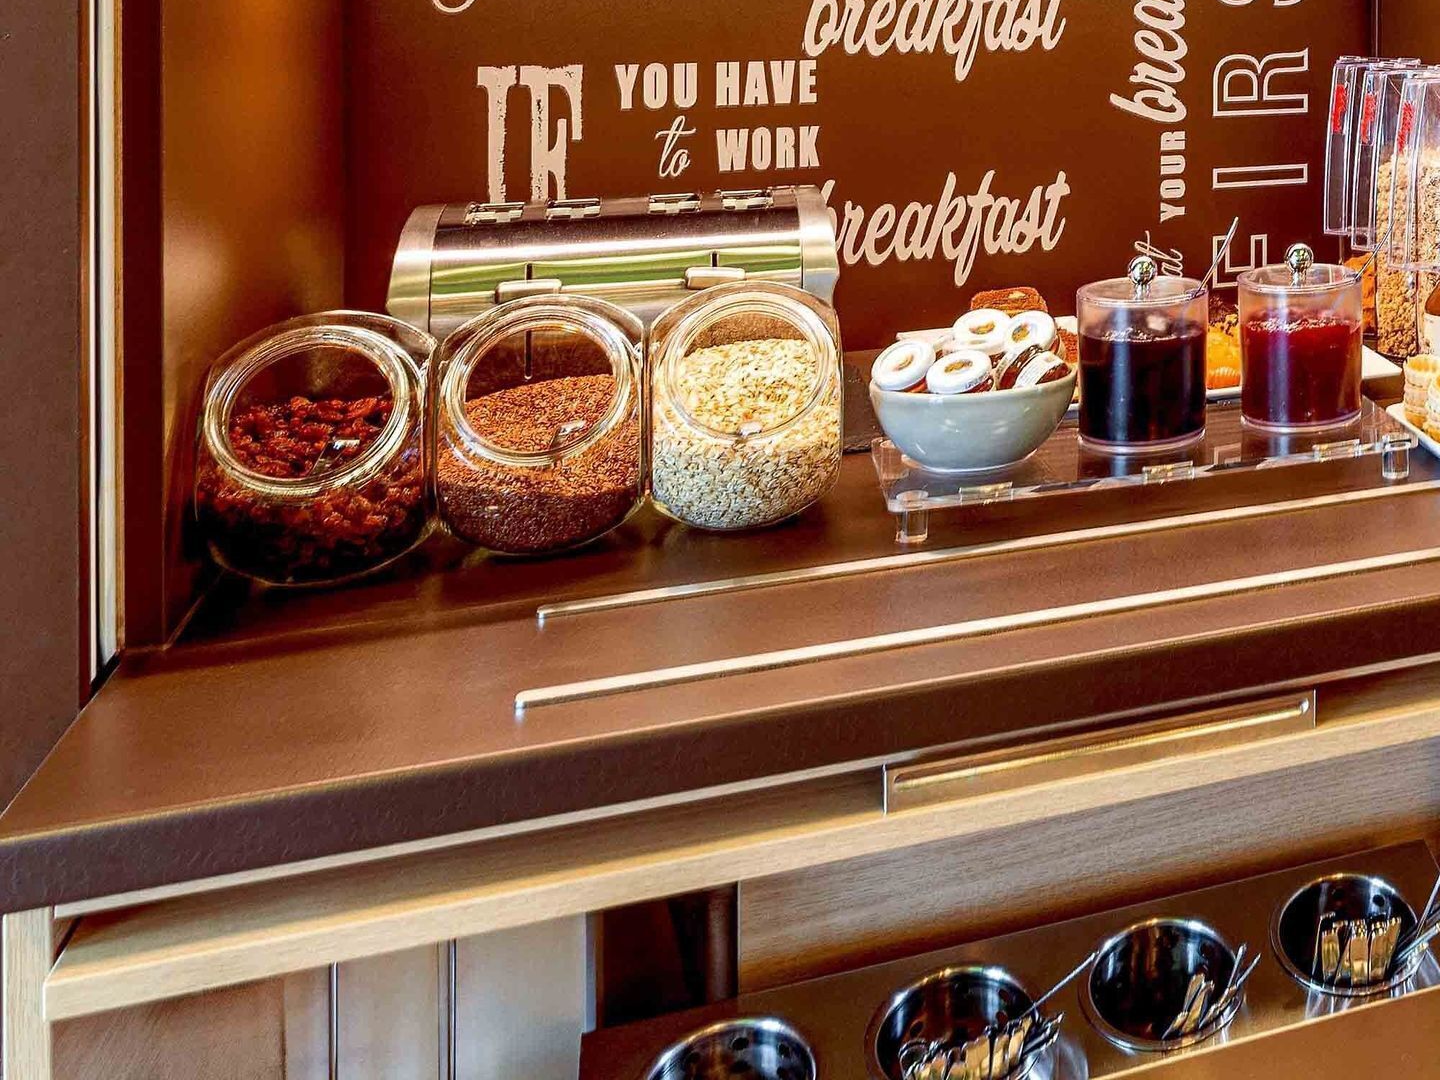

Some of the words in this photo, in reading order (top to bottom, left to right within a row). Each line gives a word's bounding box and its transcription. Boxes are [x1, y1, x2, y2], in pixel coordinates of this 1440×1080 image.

[477, 64, 583, 204] IF
[615, 63, 699, 109] YOU
[716, 59, 818, 106] HAVE
[655, 115, 697, 178] to
[716, 125, 820, 172] WORK
[1160, 130, 1187, 223] YOUR
